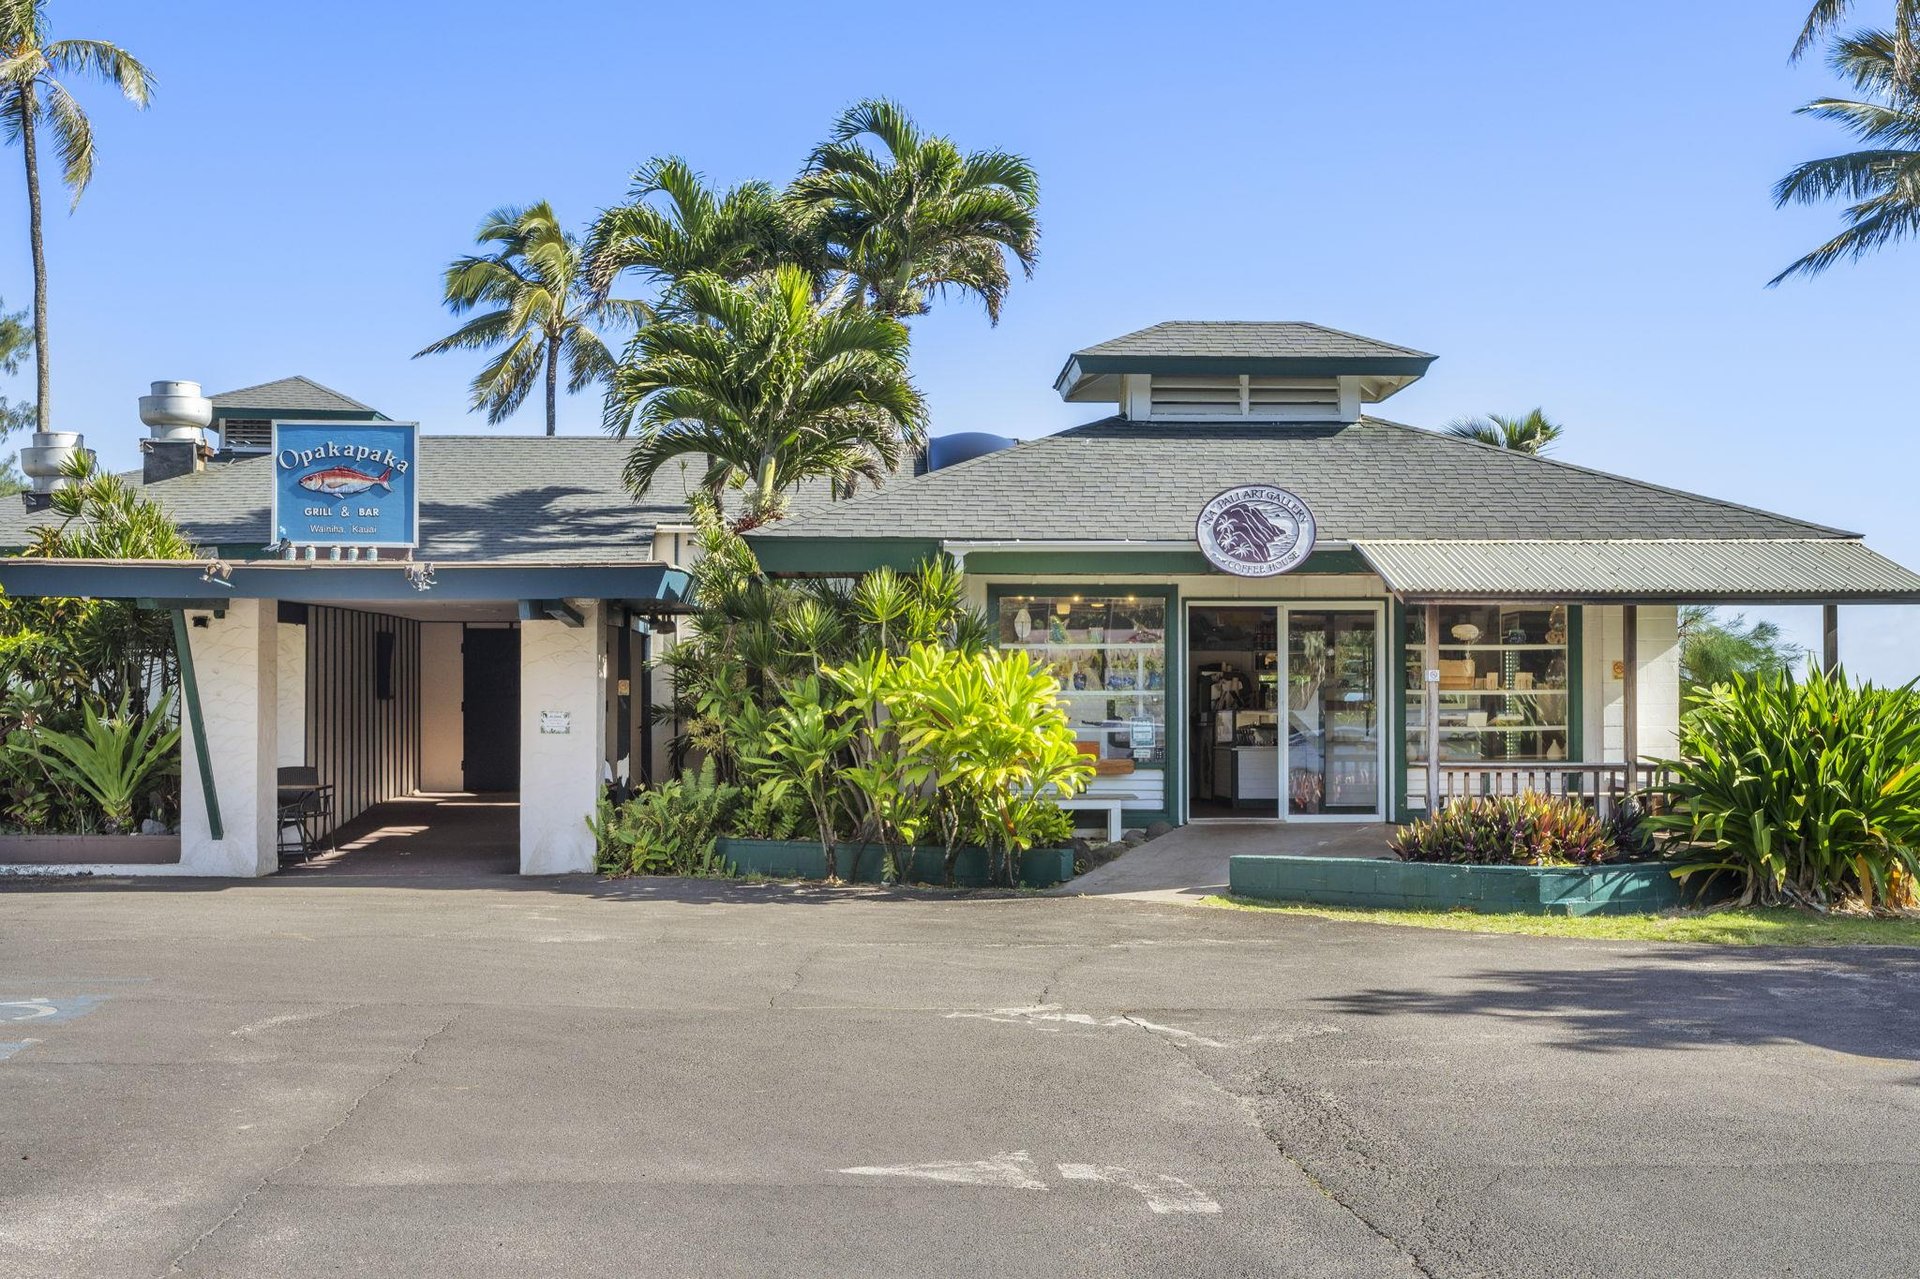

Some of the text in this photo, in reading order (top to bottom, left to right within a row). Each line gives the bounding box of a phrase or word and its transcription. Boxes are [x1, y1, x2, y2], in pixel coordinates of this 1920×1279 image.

[279, 441, 409, 473] Opakapaka
[304, 506, 380, 517] GRILL & BAR
[1218, 494, 1240, 509] PALI
[1243, 489, 1266, 499] ART
[1266, 491, 1309, 523] GALLERY
[1227, 551, 1300, 574] COFFEE HOUSE
